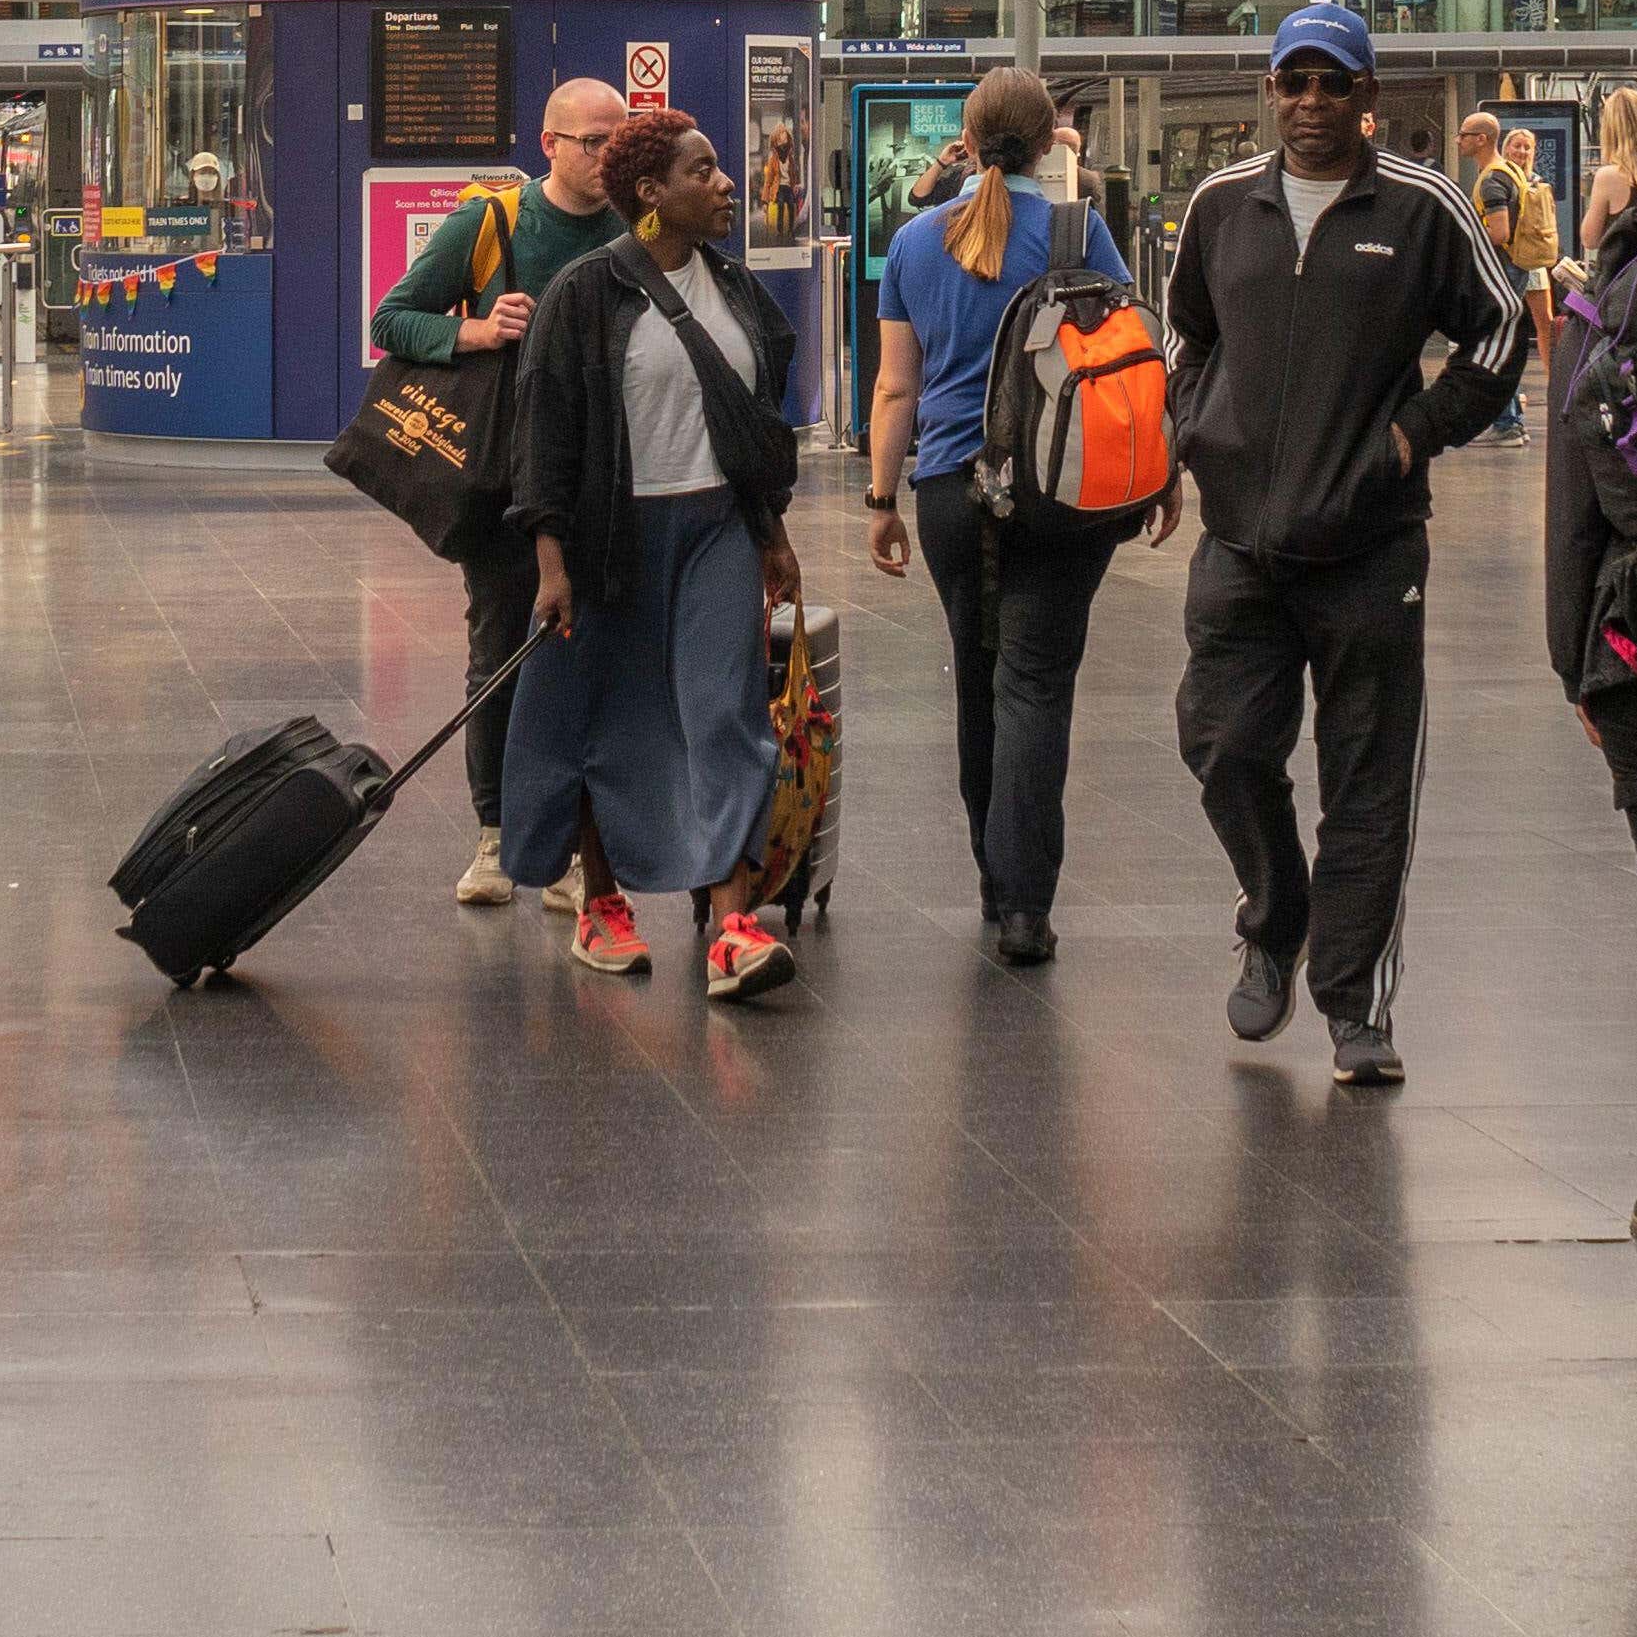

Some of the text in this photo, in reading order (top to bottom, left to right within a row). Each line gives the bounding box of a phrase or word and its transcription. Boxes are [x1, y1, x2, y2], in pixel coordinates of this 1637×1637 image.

[385, 12, 438, 23] Departures
[905, 43, 962, 52] Wide aisle gate
[914, 105, 947, 114] SEE IT.
[914, 114, 947, 124] SAY IT.
[914, 124, 957, 133] SORTED.
[395, 200, 415, 209] Scan
[443, 200, 459, 208] find
[148, 217, 167, 227] TRAIN
[168, 216, 188, 226] TIMES
[189, 216, 209, 226] ONLY
[1355, 243, 1394, 255] adidas
[109, 267, 123, 281] not
[83, 325, 191, 354] Train Information
[85, 361, 182, 397] Train times only
[401, 385, 467, 433] vintage
